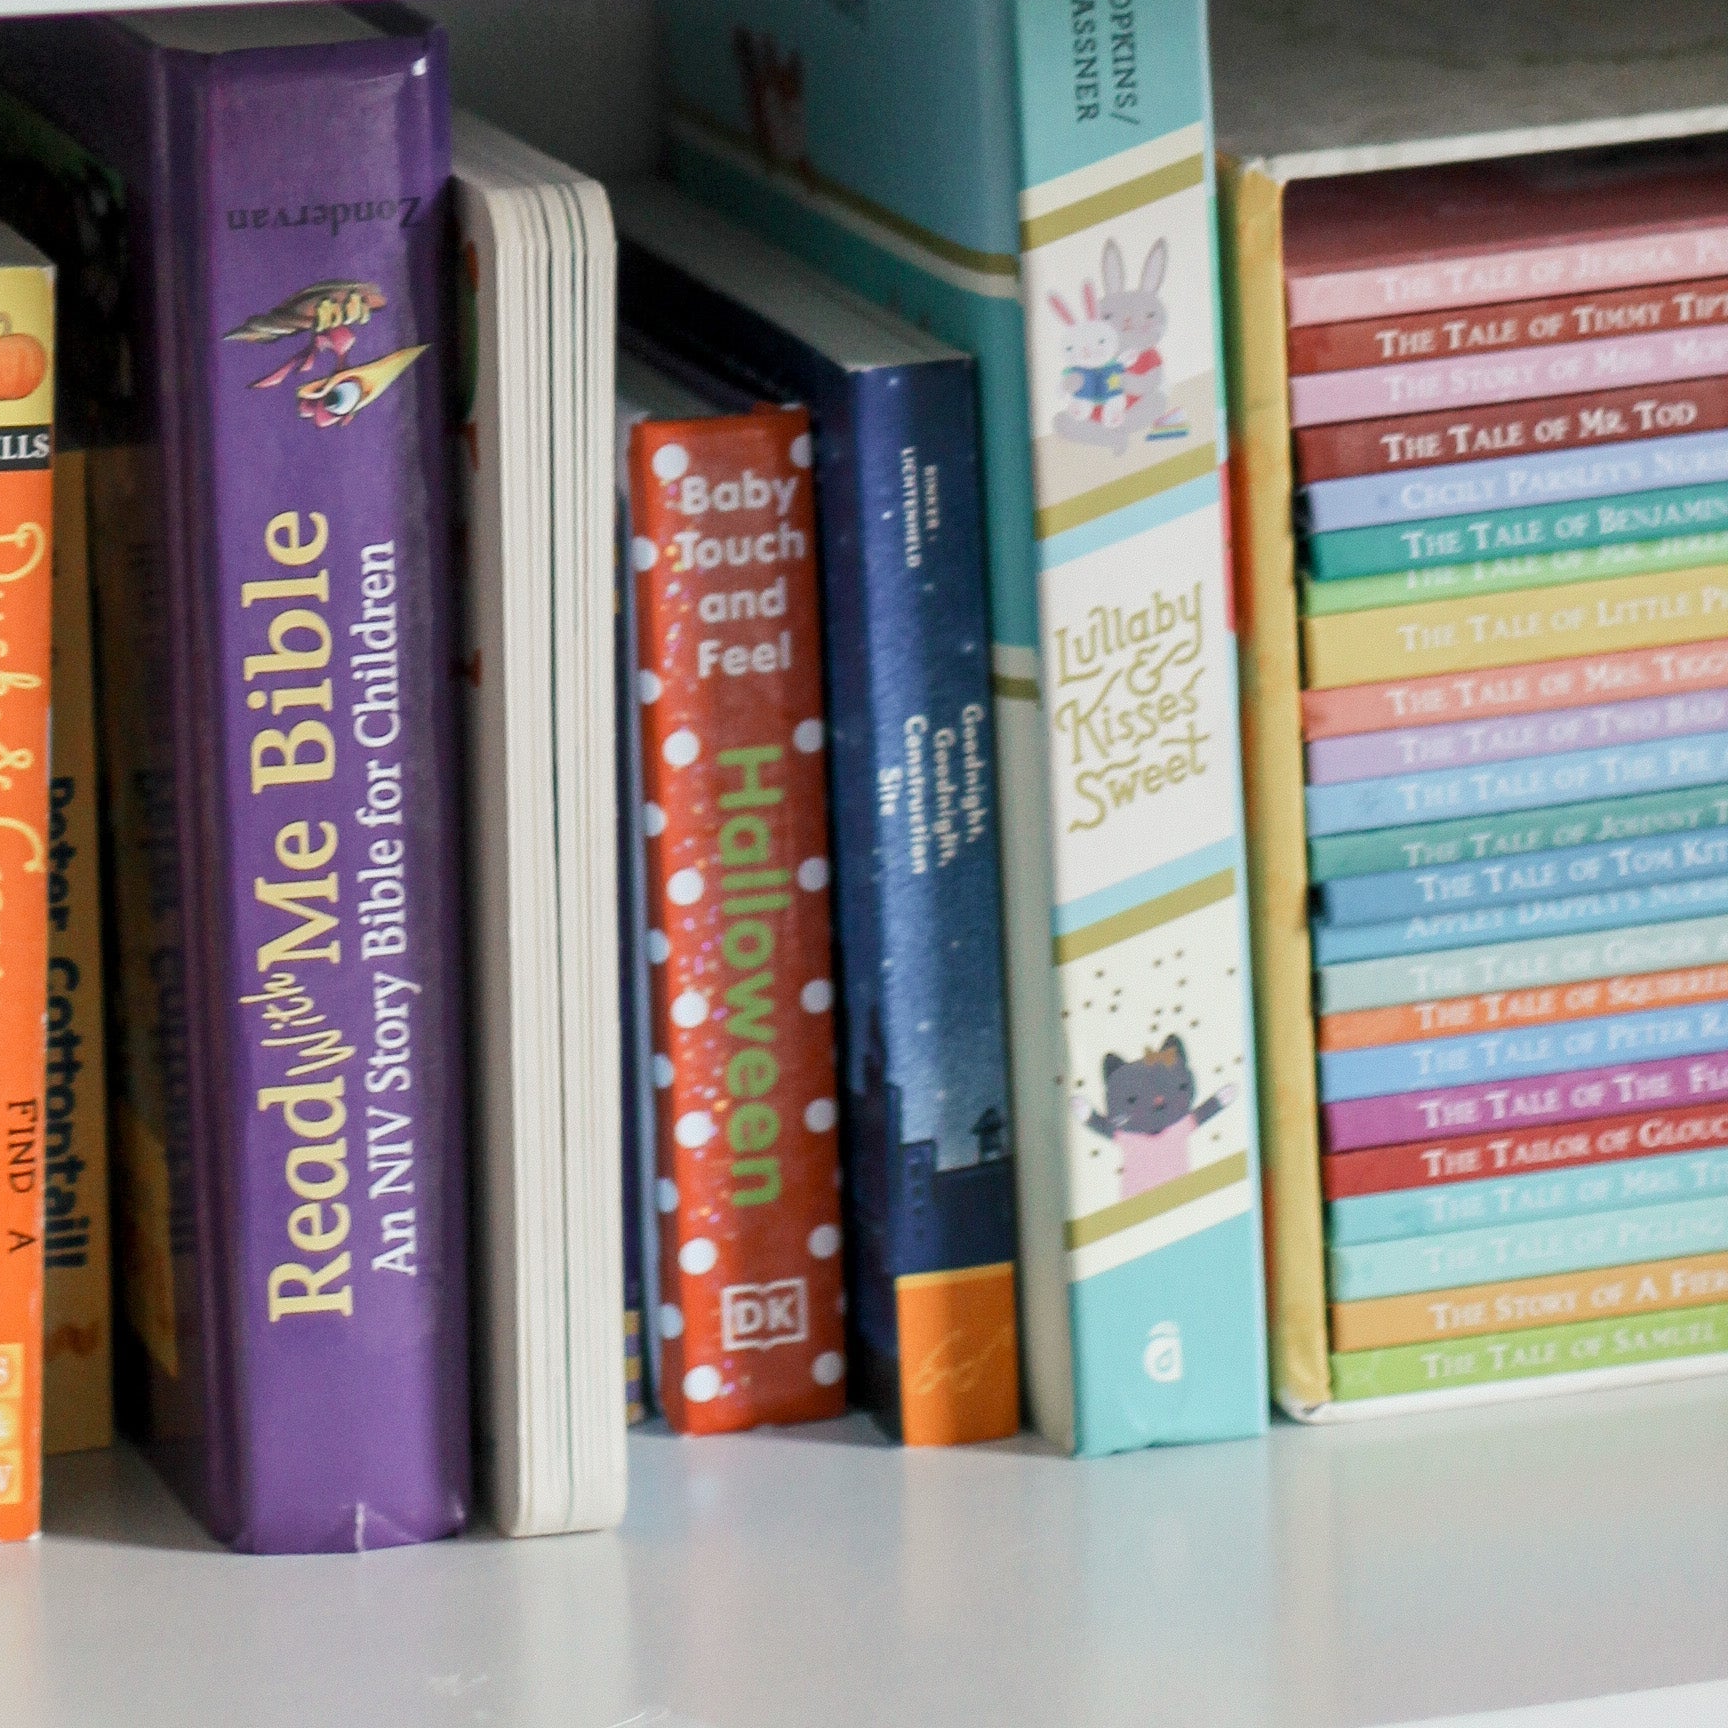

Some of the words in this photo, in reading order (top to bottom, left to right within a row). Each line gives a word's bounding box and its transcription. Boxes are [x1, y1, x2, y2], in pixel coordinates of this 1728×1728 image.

[228, 196, 421, 238] Zondervan
[1376, 329, 1436, 359] THE
[1443, 319, 1520, 350] TALE
[1528, 312, 1565, 338] OF
[1574, 300, 1665, 335] TIMMY
[1380, 432, 1442, 463] THE
[1446, 422, 1524, 455] TALE
[1534, 417, 1571, 443] OF
[1632, 399, 1698, 432] TOD
[679, 470, 799, 516] Baby
[673, 521, 806, 570] Touch
[1400, 530, 1464, 560] THE
[1468, 521, 1546, 550] TALE
[1554, 514, 1591, 540] OF
[698, 575, 788, 624] and
[1396, 622, 1457, 652] THE
[1467, 613, 1545, 643] TALE
[1551, 606, 1588, 633] OF
[1596, 594, 1694, 628] LITTLE
[240, 510, 337, 795] Bible
[349, 539, 401, 748] Children
[697, 631, 793, 679] Feel
[1055, 581, 1204, 687] Lullaby
[1126, 641, 1191, 698] &
[1054, 667, 1206, 765] Kisses
[355, 759, 404, 827] for
[877, 766, 904, 818] Site
[904, 713, 930, 875] Construction
[1068, 720, 1211, 834] Sweet
[255, 821, 342, 973] Me
[357, 839, 408, 962] Bible
[716, 745, 793, 1208] Halloween
[238, 972, 357, 1077] With
[363, 971, 421, 1094] Story
[1413, 1003, 1473, 1031] THE
[1480, 992, 1556, 1022] TALE
[1418, 1098, 1478, 1130] THE
[1485, 1088, 1562, 1121] TALE
[1572, 1081, 1606, 1110] OF
[1612, 1071, 1671, 1104] THE
[7, 1098, 39, 1195] FIND
[365, 1105, 415, 1201] NIV
[1421, 1147, 1481, 1179] THE
[1487, 1132, 1592, 1170] TAILOR
[1596, 1129, 1633, 1154] OF
[256, 1074, 353, 1324] Read
[7, 1230, 37, 1255] A
[370, 1207, 418, 1277] An
[734, 1298, 797, 1336] DK
[1427, 1300, 1489, 1332] THE
[1590, 1282, 1628, 1309] OF
[1635, 1276, 1659, 1304] A
